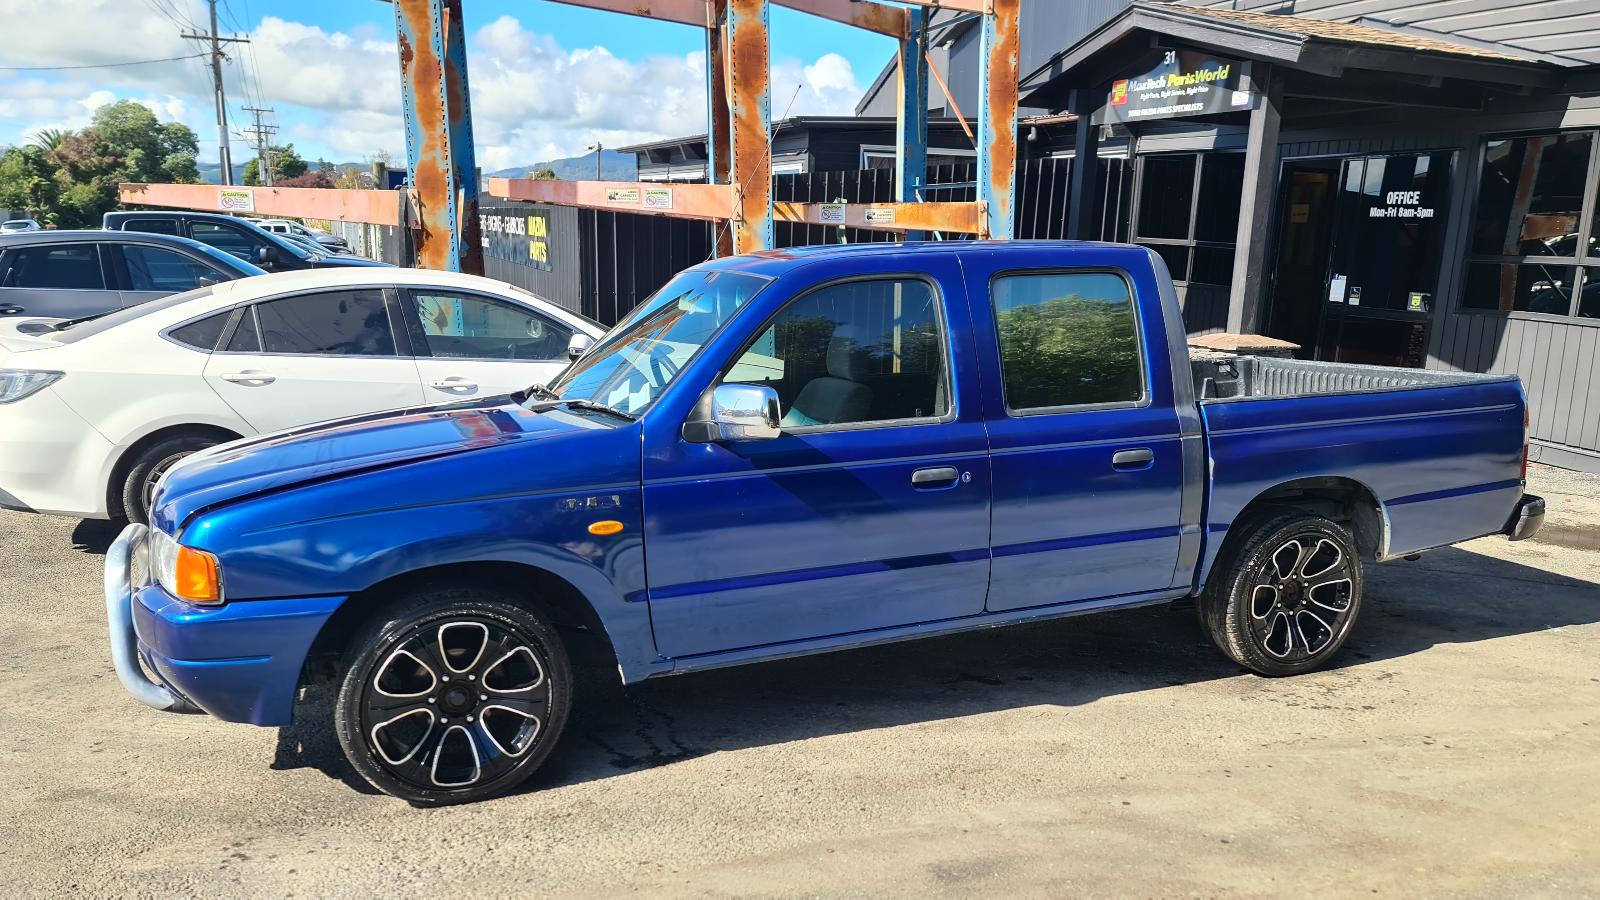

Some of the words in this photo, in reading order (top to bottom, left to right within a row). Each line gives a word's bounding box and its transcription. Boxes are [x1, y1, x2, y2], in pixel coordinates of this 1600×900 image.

[1163, 50, 1176, 64] 31
[1167, 64, 1230, 87] PartsWorld
[1387, 191, 1420, 204] OFFICE
[1369, 207, 1397, 217] Mon-Fri
[1398, 207, 1433, 218] 8am-5pm
[528, 215, 547, 238] MAZDA
[530, 240, 547, 263] PARTS
